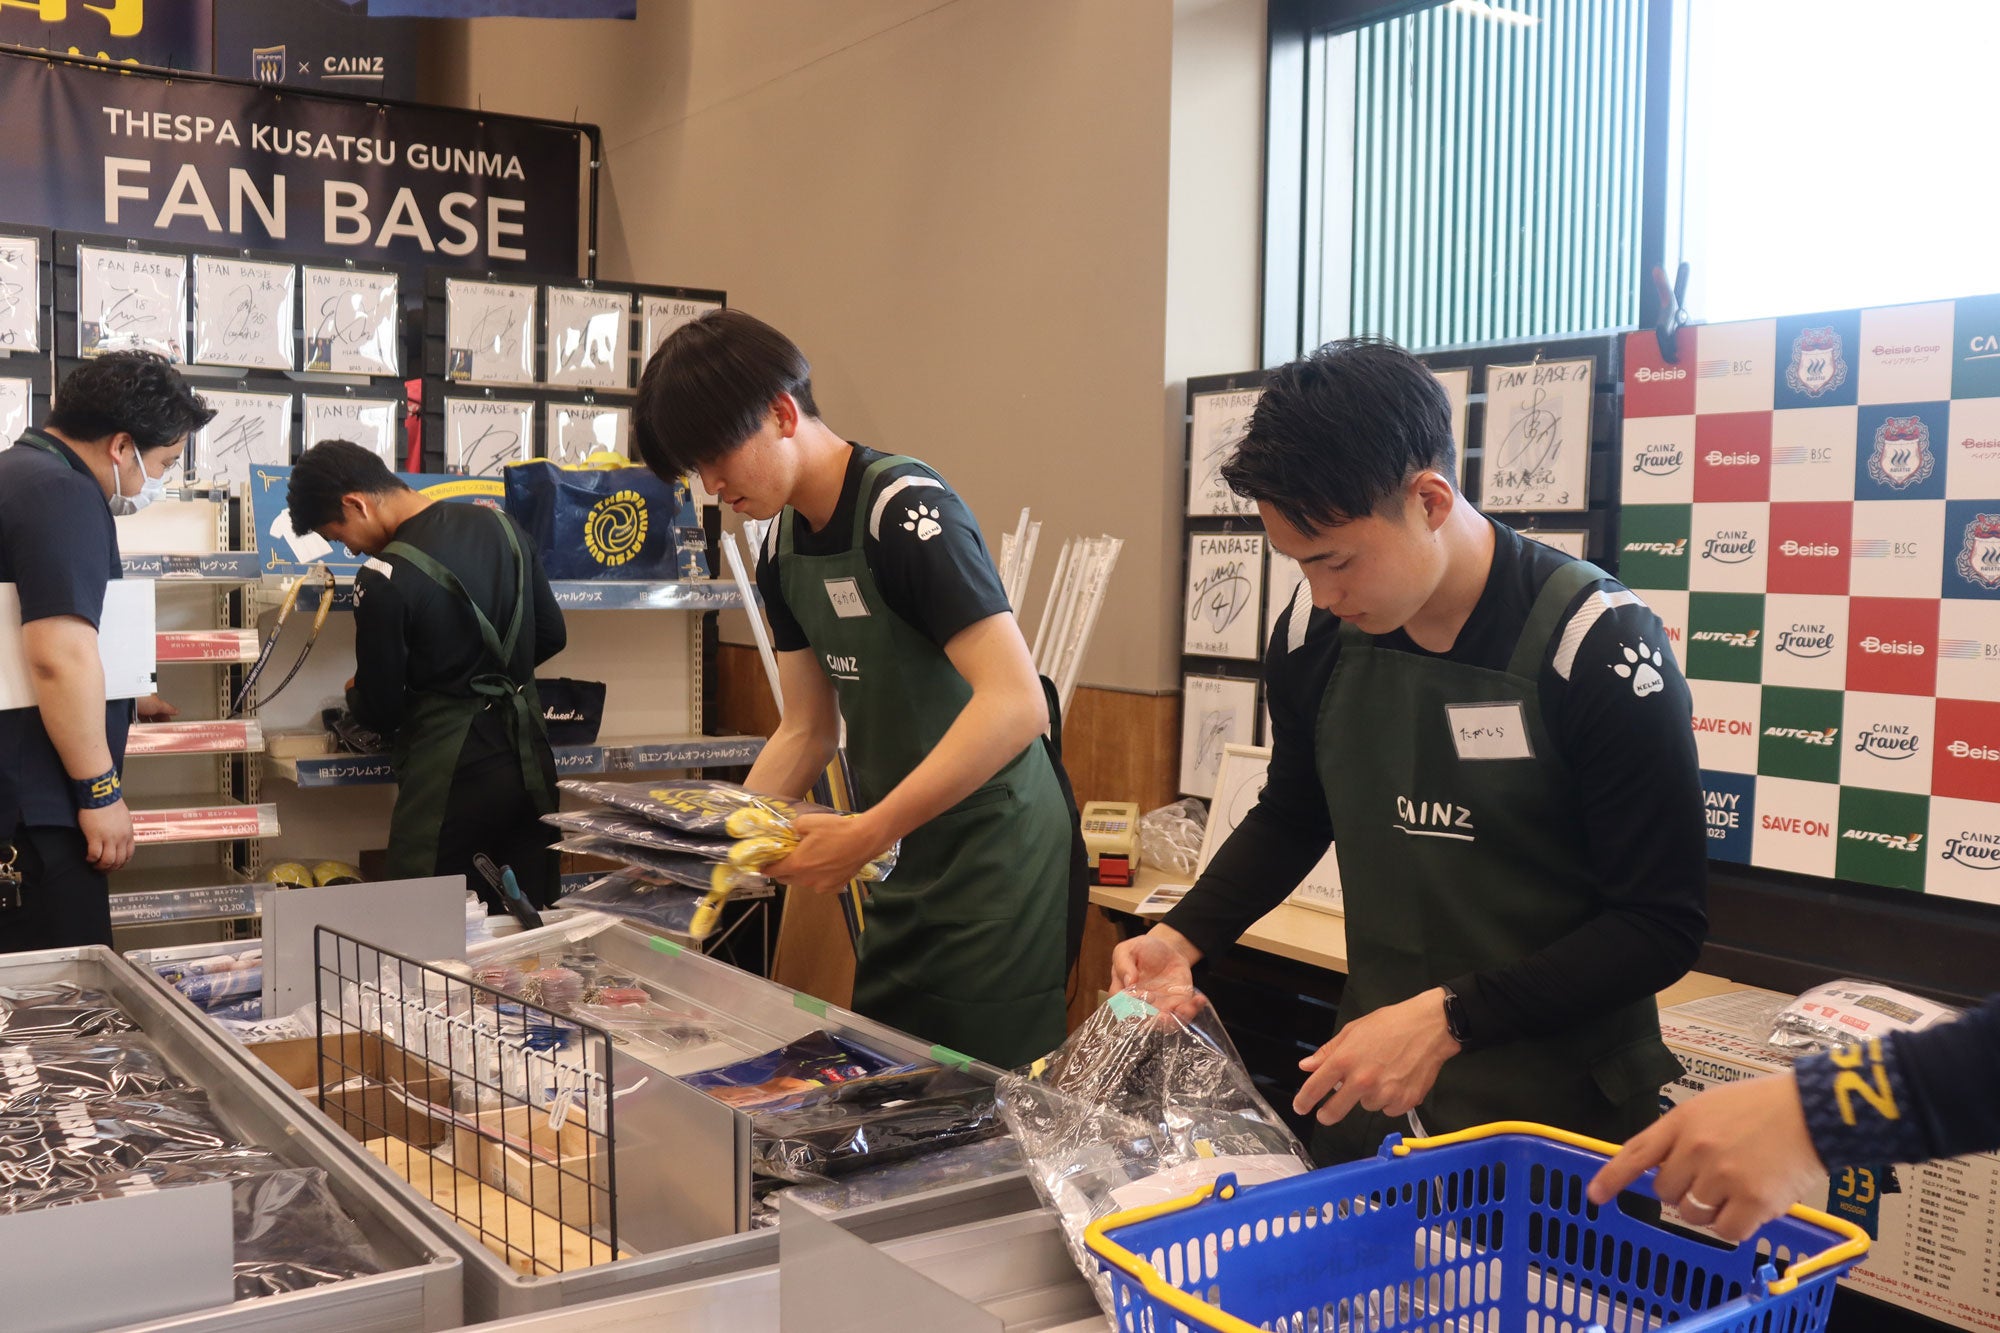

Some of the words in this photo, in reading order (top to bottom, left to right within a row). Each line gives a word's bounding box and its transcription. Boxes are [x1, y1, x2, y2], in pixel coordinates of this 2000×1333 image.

[323, 56, 384, 72] CAINZ
[102, 106, 241, 147] THESPA
[252, 125, 397, 165] KUSATSU
[406, 144, 526, 181] GUNMA
[104, 156, 287, 240] FAN
[323, 179, 528, 262] BASE
[207, 263, 230, 276] FAN
[240, 268, 273, 279] BASE
[312, 274, 330, 285] FAN
[339, 277, 365, 287] BASE
[649, 303, 668, 316] FAN
[673, 304, 697, 316] BASE
[1914, 343, 1941, 354] Group
[1733, 360, 1753, 373] BSC
[1497, 371, 1527, 391] FAN
[1533, 365, 1570, 386] BASE
[452, 403, 476, 414] FAN
[480, 403, 510, 415] BASE
[1646, 443, 1676, 453] CAINZ
[1811, 448, 1832, 461] BSC
[1633, 452, 1684, 472] Travel
[1716, 531, 1748, 540] CAINZ
[1702, 538, 1757, 560] Travel
[1894, 542, 1918, 556] BSC
[1791, 623, 1826, 634] CAINZ
[1775, 632, 1835, 652] Travel
[826, 653, 859, 672] CAINZ
[1636, 678, 1662, 691] KELME
[1691, 716, 1726, 733] SAVE
[1728, 719, 1752, 736] ON
[1872, 723, 1910, 736] CAINZ
[1855, 731, 1920, 753] Travel
[1396, 795, 1475, 830] CAINZ
[1761, 814, 1801, 834] SAVE
[1803, 820, 1830, 838] ON
[1694, 1059, 1740, 1082] SEASON
